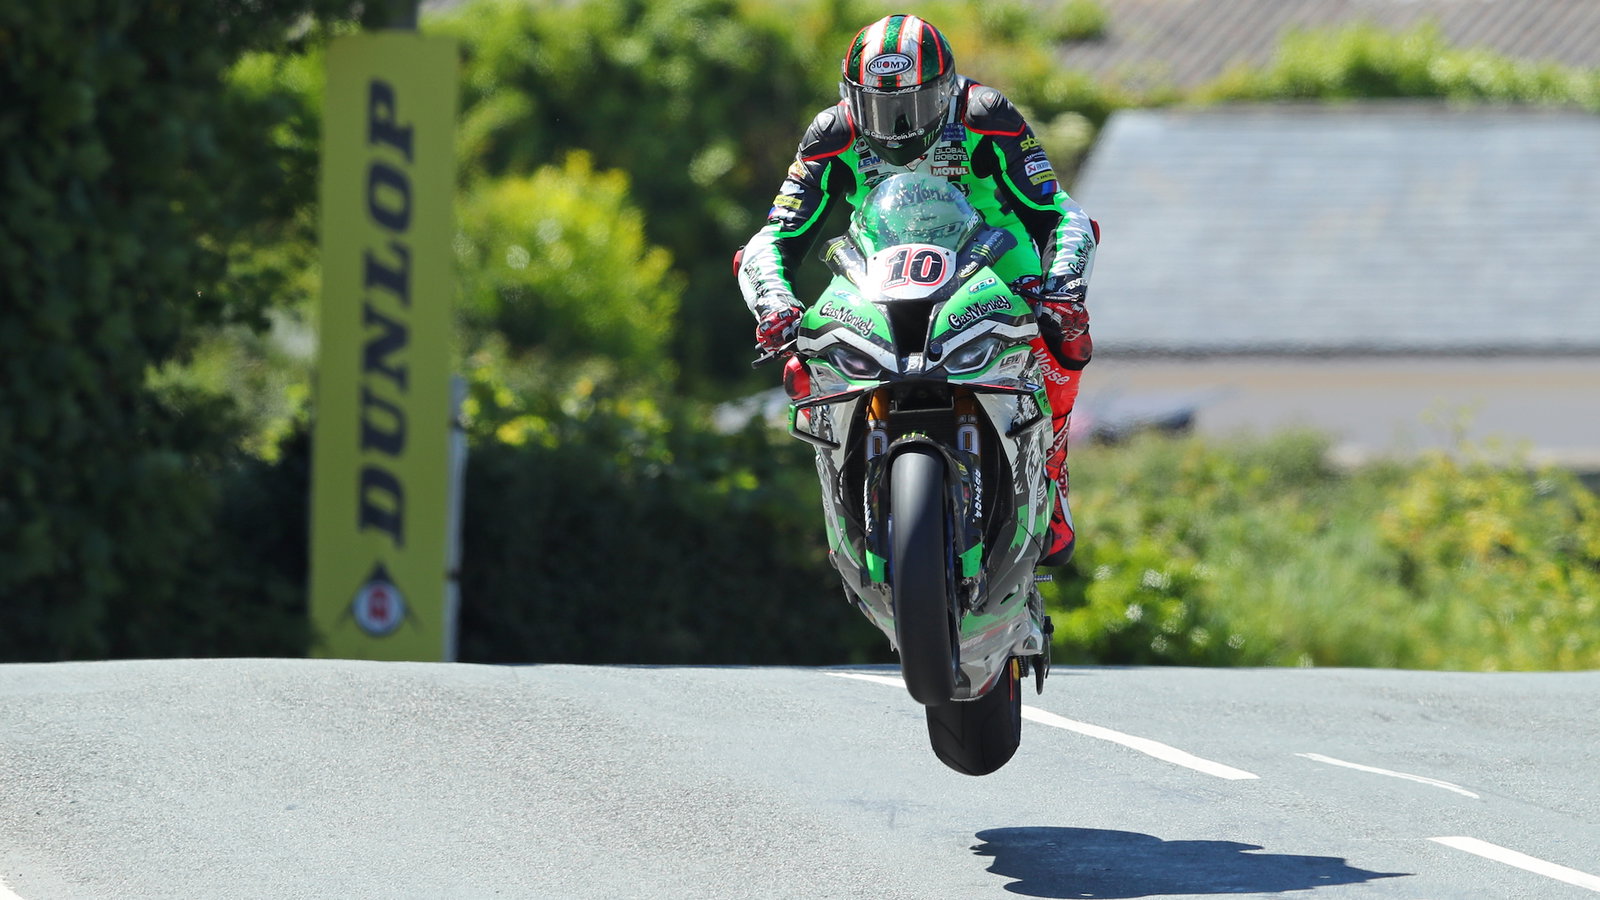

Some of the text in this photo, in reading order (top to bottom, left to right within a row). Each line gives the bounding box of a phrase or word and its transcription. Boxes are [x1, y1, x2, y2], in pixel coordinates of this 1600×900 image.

[871, 60, 908, 69] SUOMY
[870, 130, 917, 141] CasinoCoin.im
[933, 167, 968, 176] MOTUL
[883, 248, 946, 289] 10
[358, 78, 414, 548] DUNLOP
[820, 301, 875, 337] GasMonkey
[948, 295, 1012, 331] GasMonkey
[1033, 347, 1070, 386] Weise
